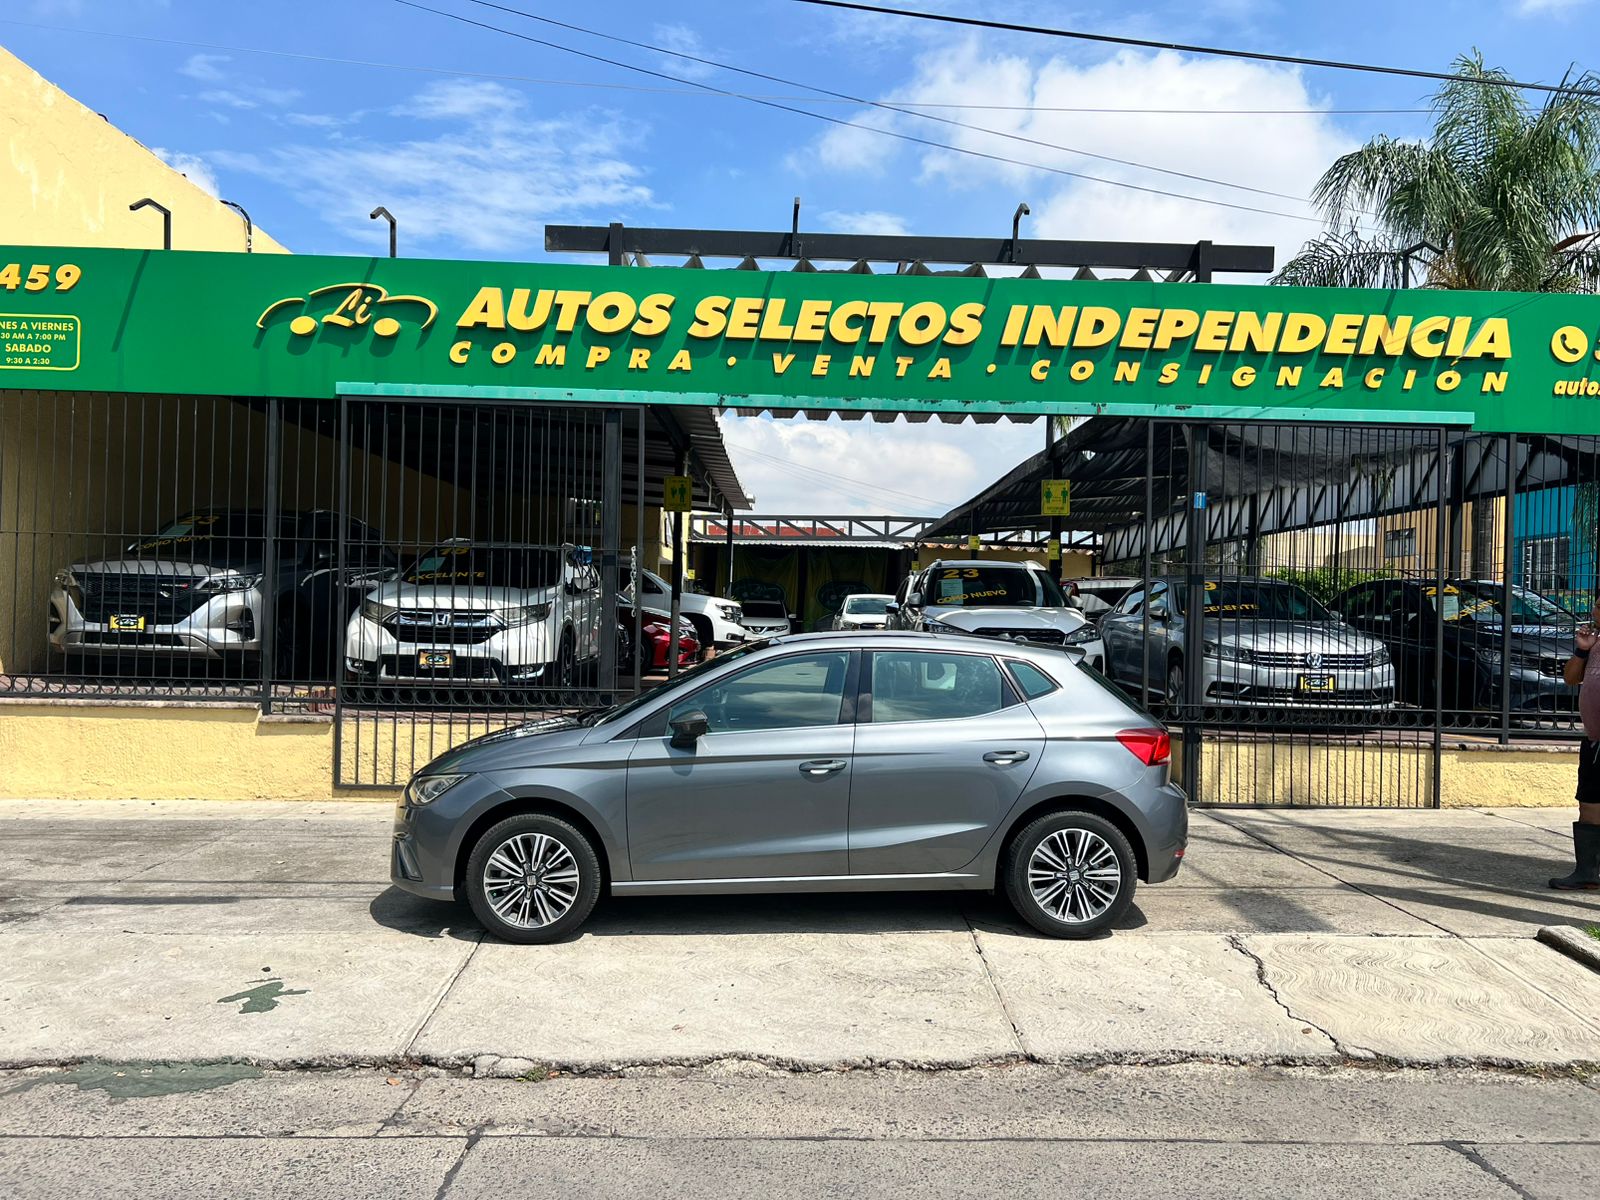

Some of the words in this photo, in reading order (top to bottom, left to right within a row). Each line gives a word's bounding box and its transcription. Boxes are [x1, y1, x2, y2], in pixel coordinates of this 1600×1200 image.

[0, 264, 82, 291] 459
[321, 288, 373, 328] Li
[20, 322, 28, 330] A
[31, 322, 74, 331] VIERNES
[457, 287, 675, 336] AUTOS
[688, 296, 986, 345] SELECTOS
[1001, 305, 1512, 359] INDEPENDENCIA
[5, 343, 52, 353] SABADO
[450, 341, 692, 371] COMPRA
[773, 353, 951, 378] VENTA
[1031, 358, 1508, 392] CONSIGNACIÓN
[1553, 378, 1600, 396] auto
[943, 568, 980, 579] 23
[936, 594, 969, 604] COMO
[971, 589, 1007, 600] NUEVO
